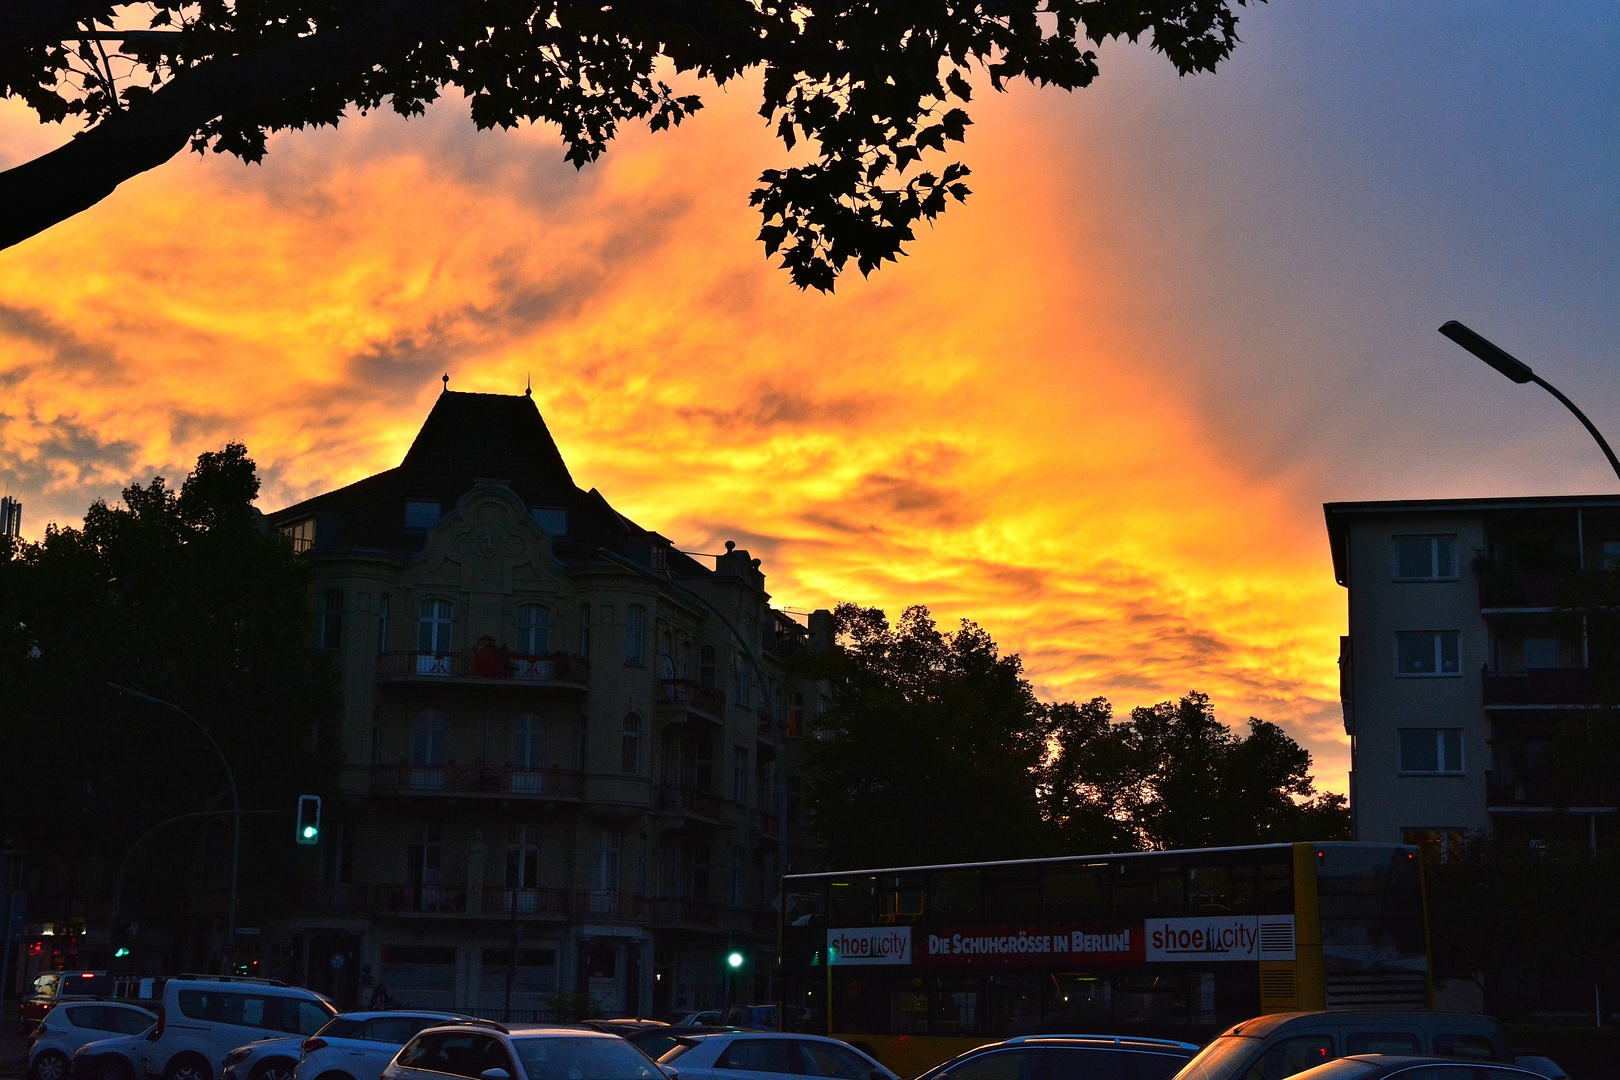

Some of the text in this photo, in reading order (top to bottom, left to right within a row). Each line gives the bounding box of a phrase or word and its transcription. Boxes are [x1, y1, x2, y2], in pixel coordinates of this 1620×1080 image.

[832, 932, 906, 959] shoe city
[928, 929, 1130, 954] DIE SCHUHGRÖSSE IN BERLIN!
[1152, 922, 1257, 953] shoe city
